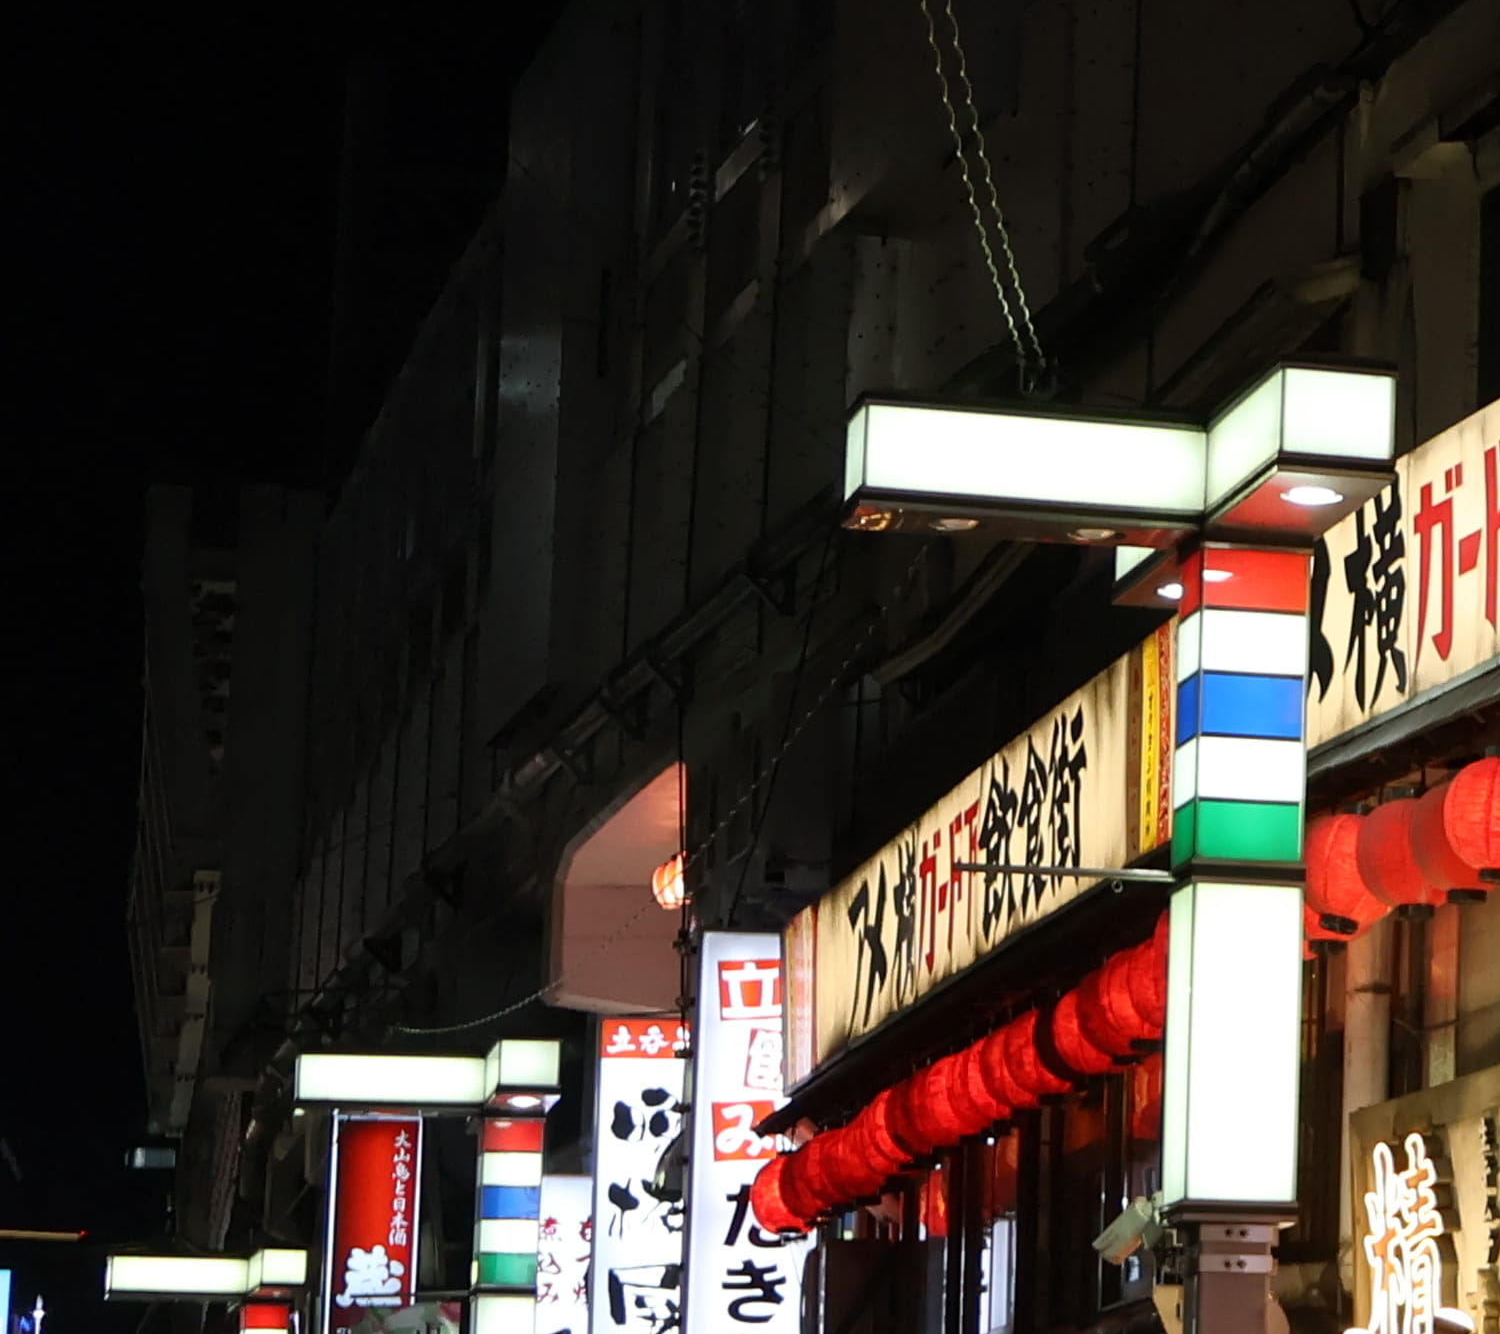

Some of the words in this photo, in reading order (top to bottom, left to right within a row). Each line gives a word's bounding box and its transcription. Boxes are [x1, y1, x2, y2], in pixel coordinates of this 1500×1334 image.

[848, 703, 1088, 1039] アメ横ガード下飲食街
